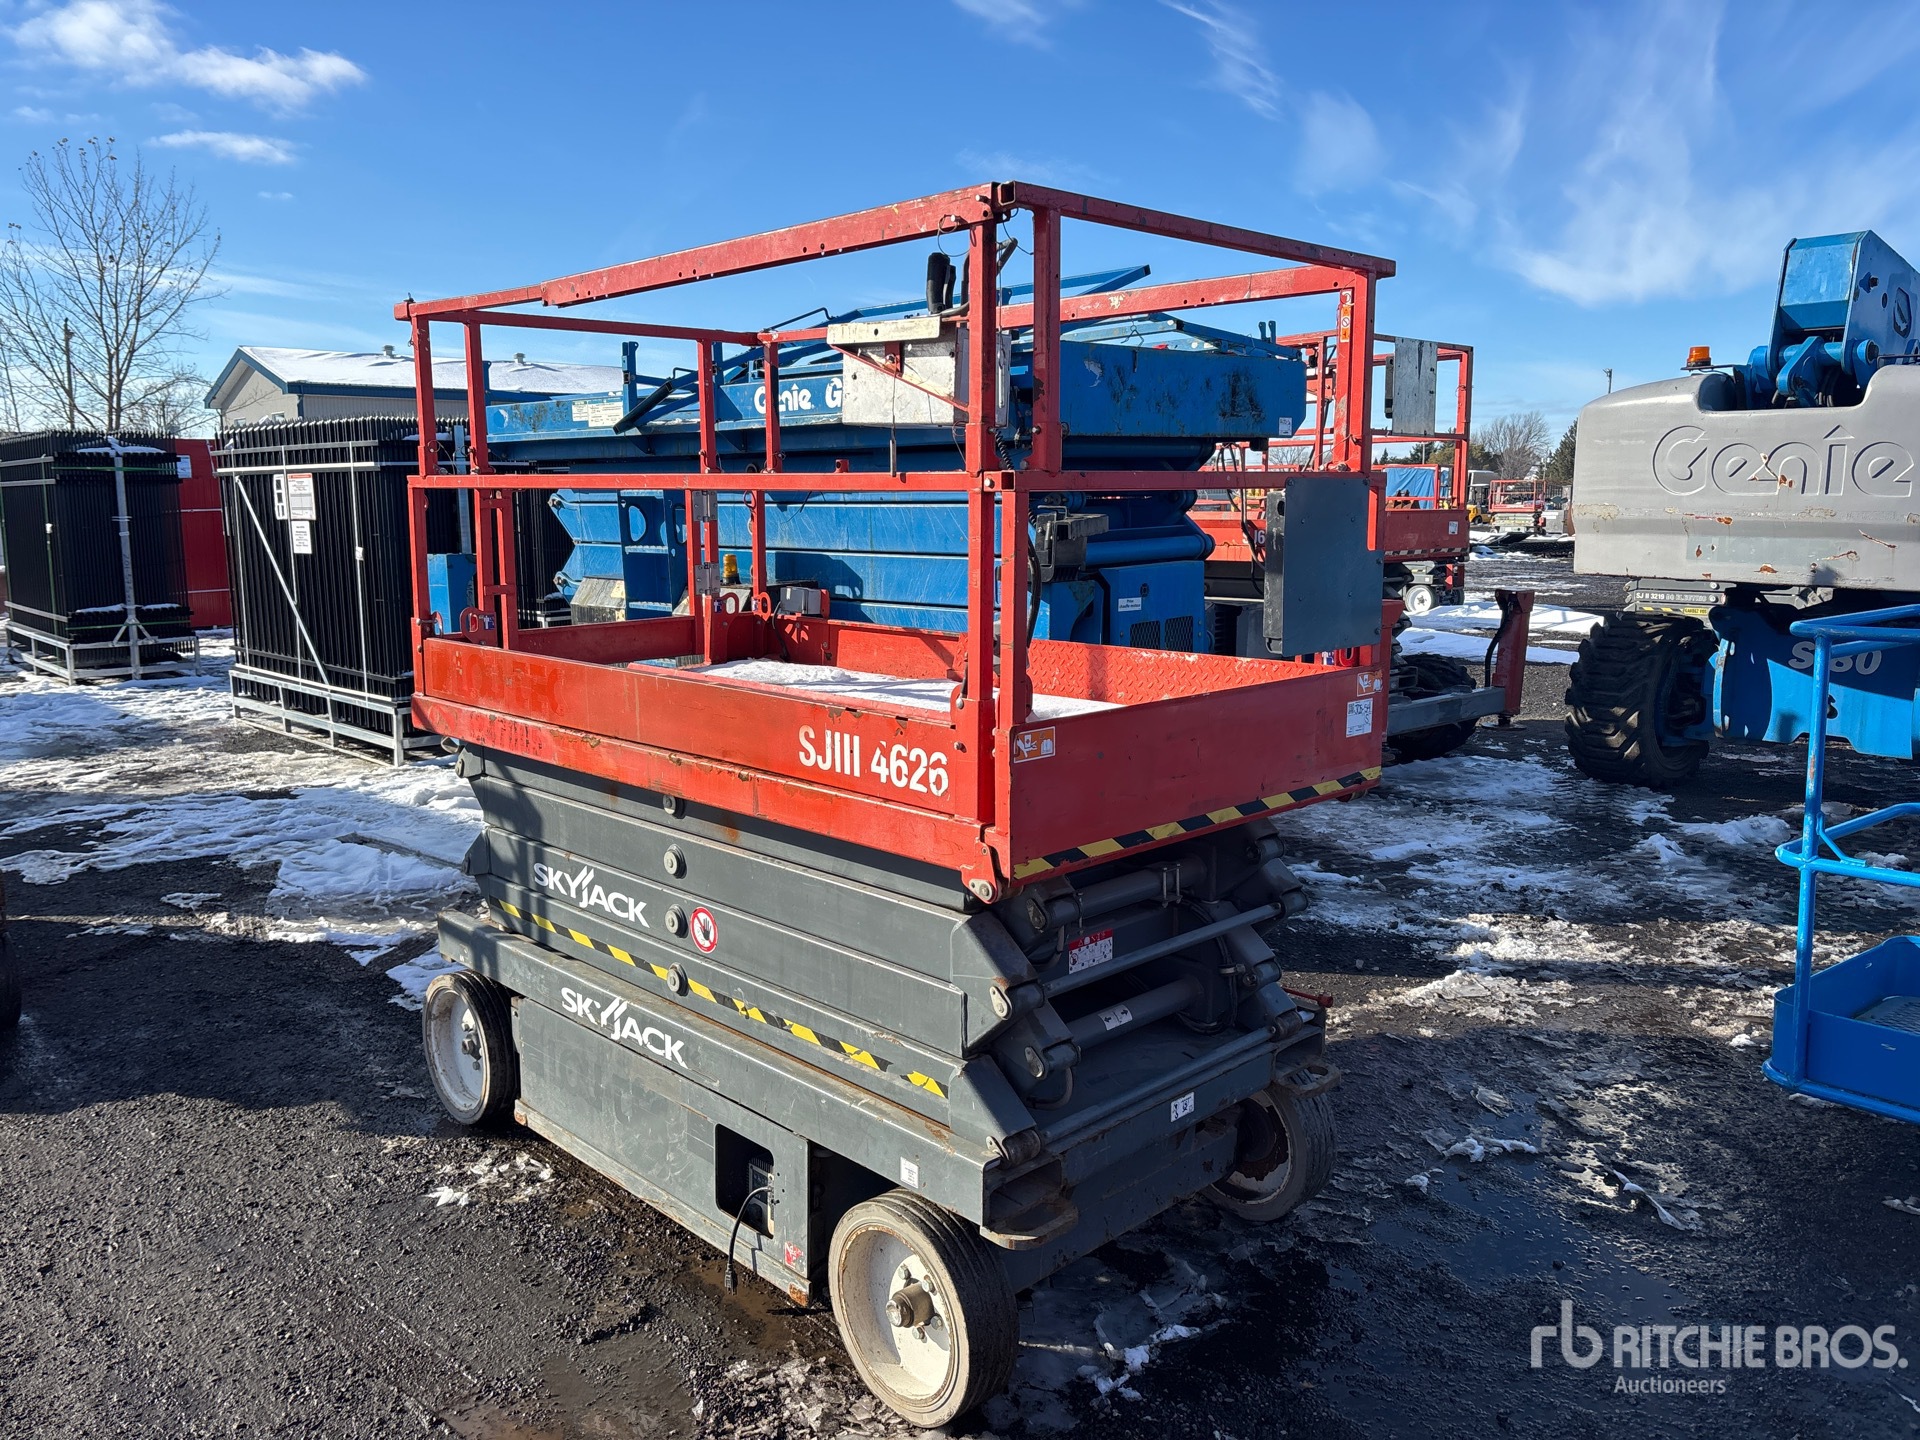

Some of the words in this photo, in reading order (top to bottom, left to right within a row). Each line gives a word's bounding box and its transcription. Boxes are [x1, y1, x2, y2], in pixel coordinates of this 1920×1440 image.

[754, 383, 812, 414] Gnie
[1652, 424, 1914, 498] Genie
[798, 724, 861, 778] SJIII
[870, 740, 949, 797] 4626
[533, 862, 650, 928] SKYJACK
[561, 986, 689, 1070] SKYJACK
